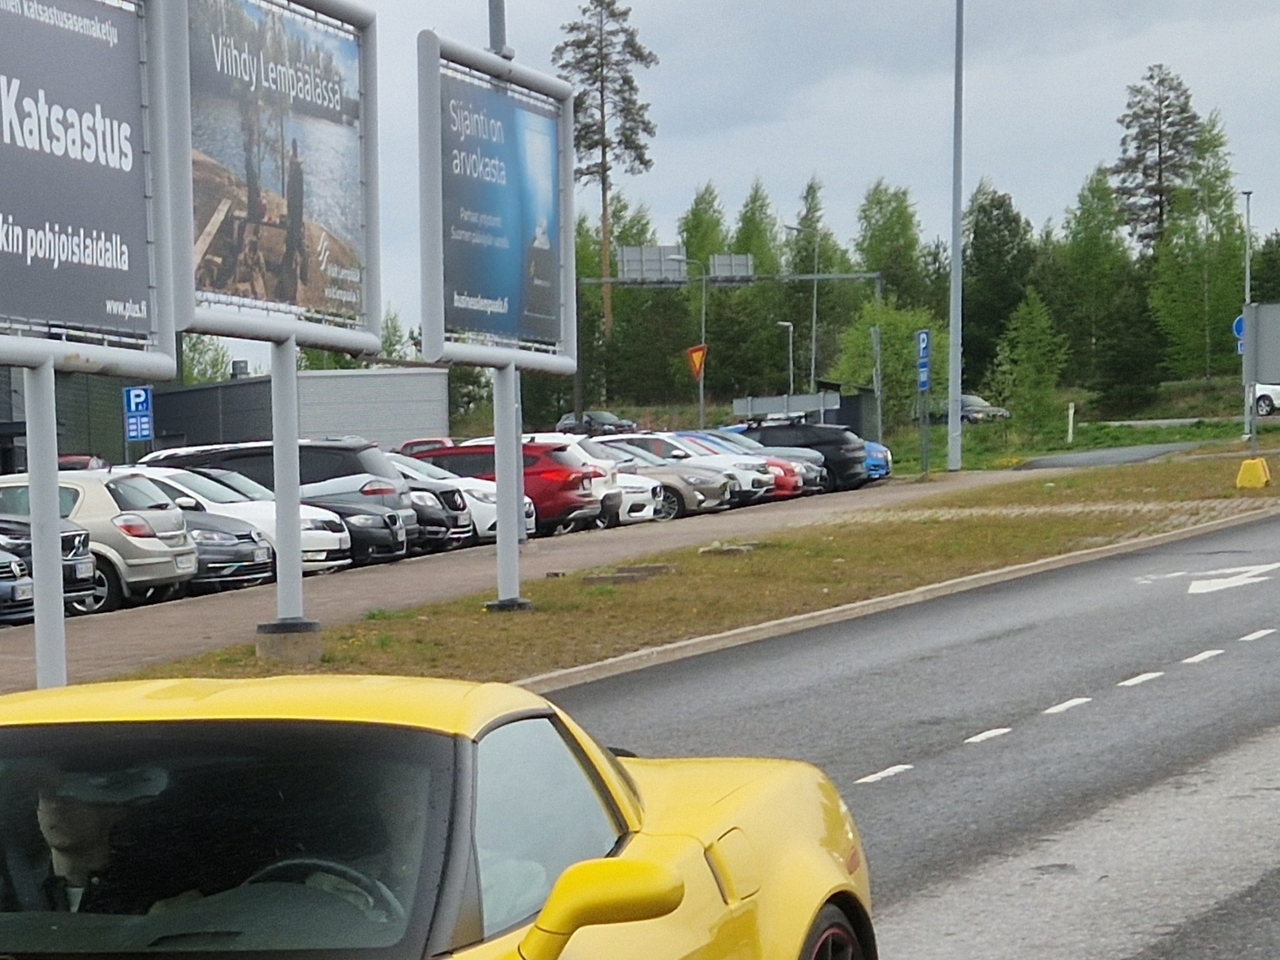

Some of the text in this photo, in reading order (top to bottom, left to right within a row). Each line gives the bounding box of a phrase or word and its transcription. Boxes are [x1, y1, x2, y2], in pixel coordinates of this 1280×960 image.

[211, 33, 341, 111] Viihdy Lempäälässä
[0, 74, 133, 172] Katsastus
[449, 99, 505, 144] Sijainti on
[452, 146, 507, 185] arvokasta
[26, 222, 129, 271] pohjoislaidalla
[130, 389, 146, 411] P
